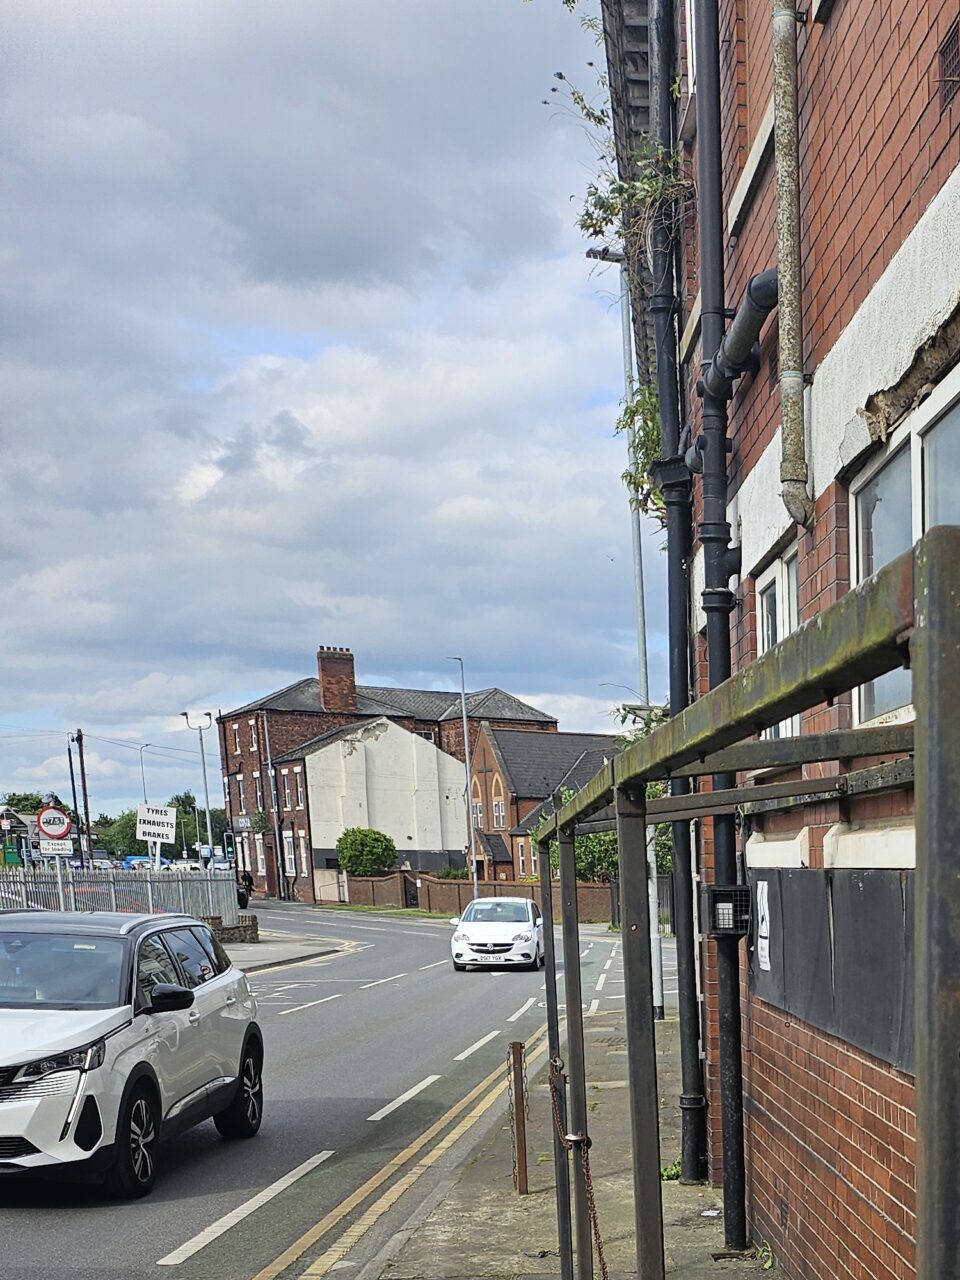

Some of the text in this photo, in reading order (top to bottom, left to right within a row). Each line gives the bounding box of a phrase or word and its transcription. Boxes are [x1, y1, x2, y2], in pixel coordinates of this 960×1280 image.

[146, 807, 169, 816] TYRES
[139, 818, 174, 829] EXHAUSTS
[142, 830, 170, 840] BRAKES
